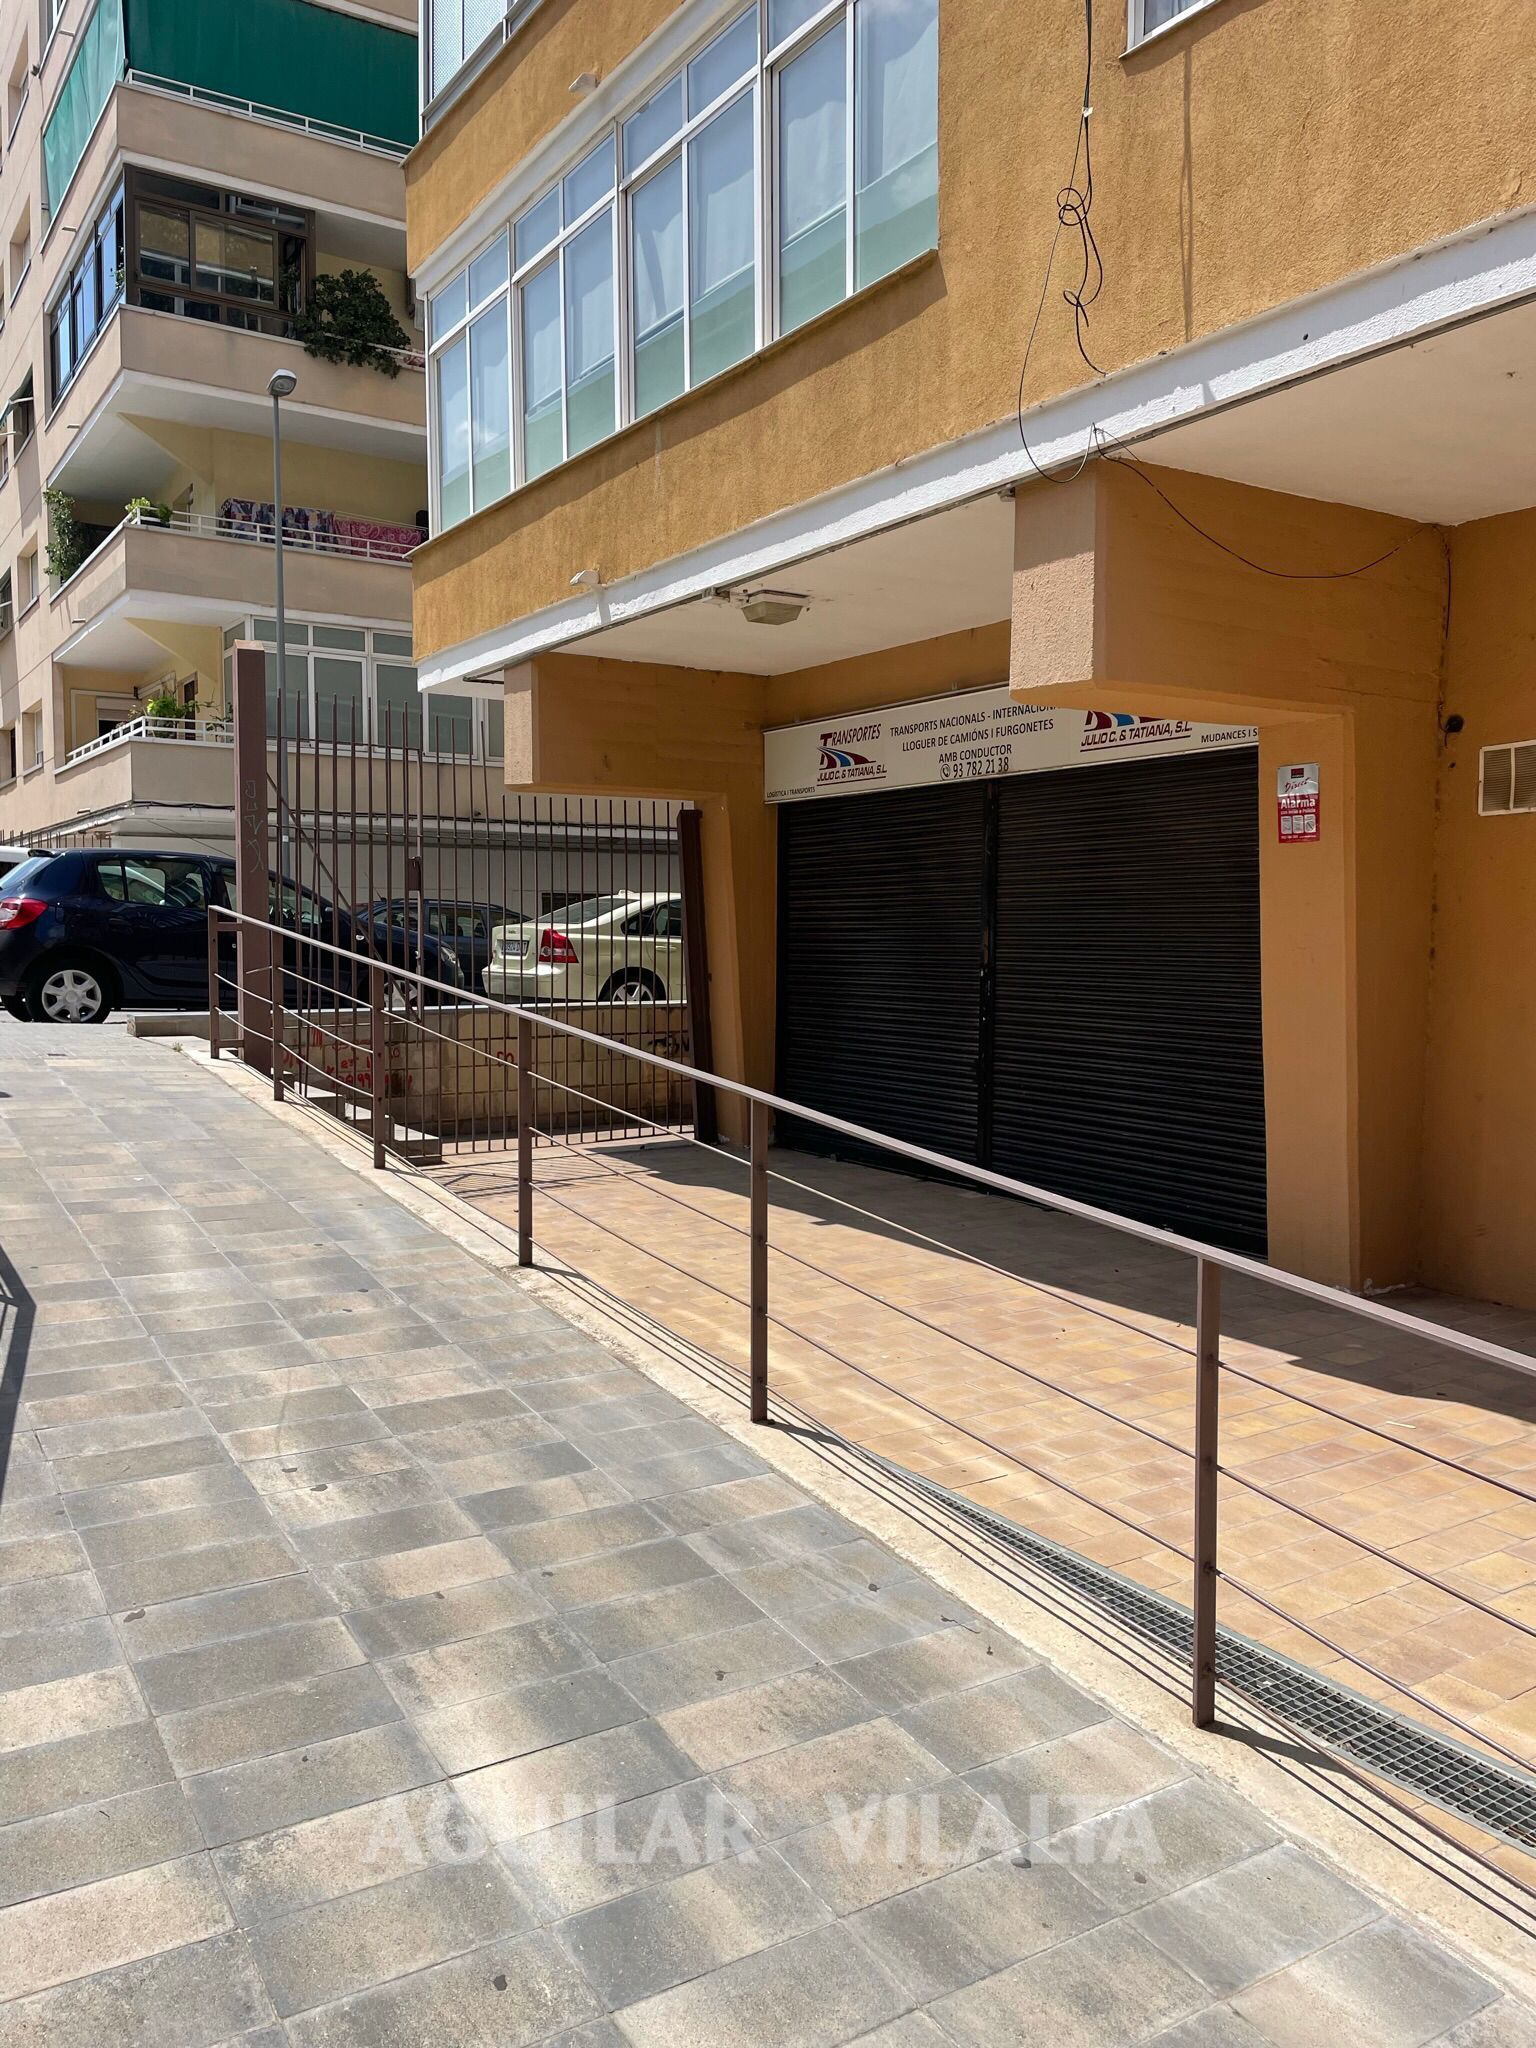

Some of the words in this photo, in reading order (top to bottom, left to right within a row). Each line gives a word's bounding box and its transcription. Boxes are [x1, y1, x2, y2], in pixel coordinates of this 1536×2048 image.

[820, 723, 882, 747] TRANSPORTES
[890, 720, 938, 737] TRANSPORTS
[939, 711, 986, 728] NACIONALS
[902, 737, 936, 752] LLOGUER
[937, 735, 948, 747] DE
[950, 728, 989, 745] CAMIÓNS
[995, 718, 1054, 737] FURGONETES
[1119, 729, 1127, 742] &
[1128, 722, 1173, 740] TATIANA,
[1174, 720, 1193, 734] S.L.
[1200, 729, 1247, 744] MUDANCES
[938, 752, 958, 764] AMB
[959, 743, 1012, 761] CONDUCTOR
[953, 763, 964, 778] 93
[966, 760, 983, 777] 782
[985, 758, 995, 774] 21
[998, 756, 1009, 772] 38
[1280, 797, 1316, 810] Alarma
